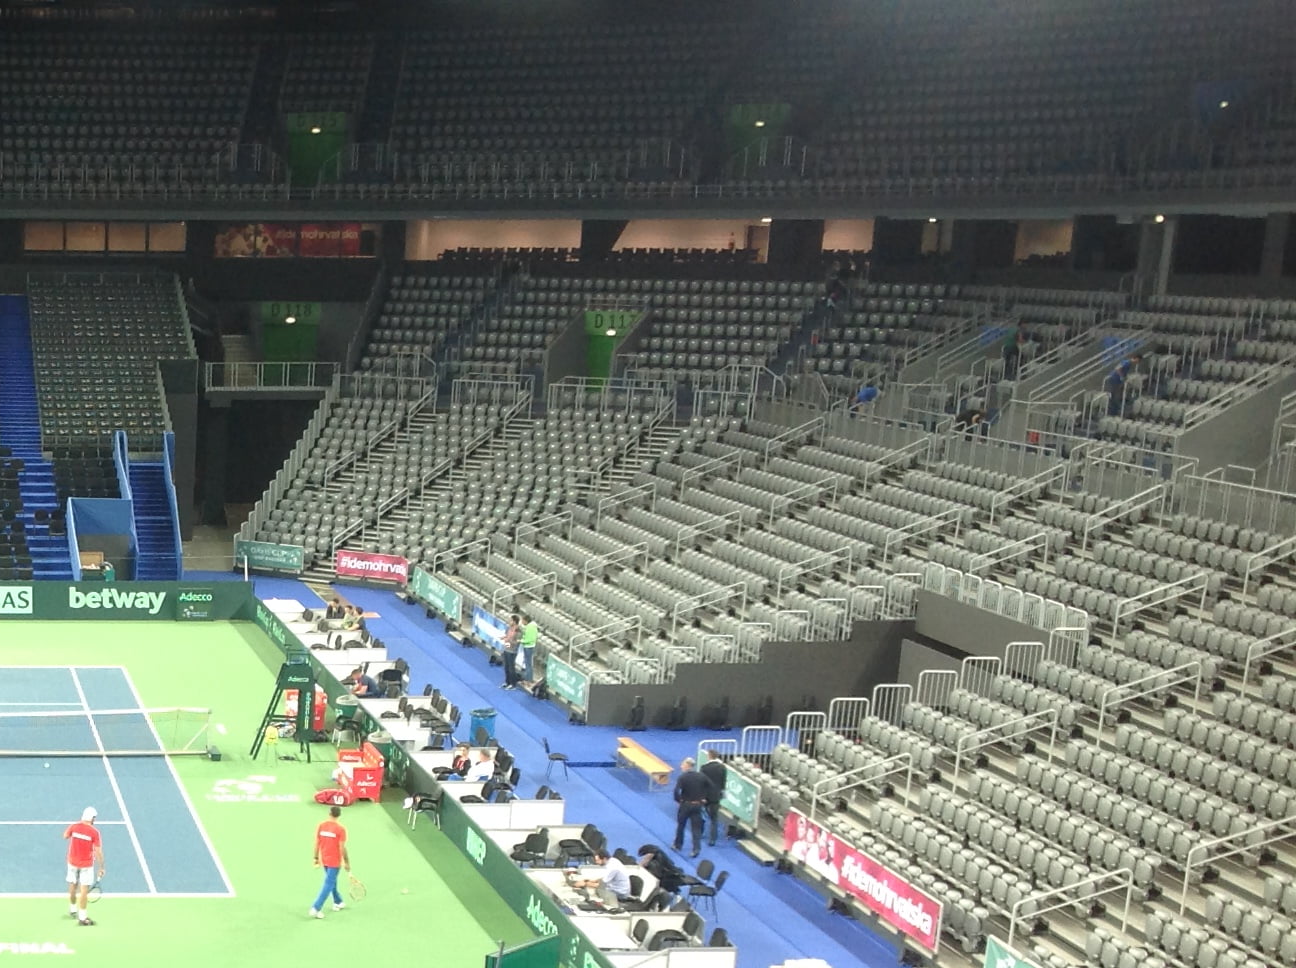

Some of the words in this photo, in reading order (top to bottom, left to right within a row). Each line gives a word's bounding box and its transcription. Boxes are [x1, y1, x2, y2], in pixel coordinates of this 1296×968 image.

[594, 314, 604, 329] D
[68, 586, 167, 615] betway
[179, 592, 213, 602] Adecco
[841, 855, 933, 936] #idemohrvatska
